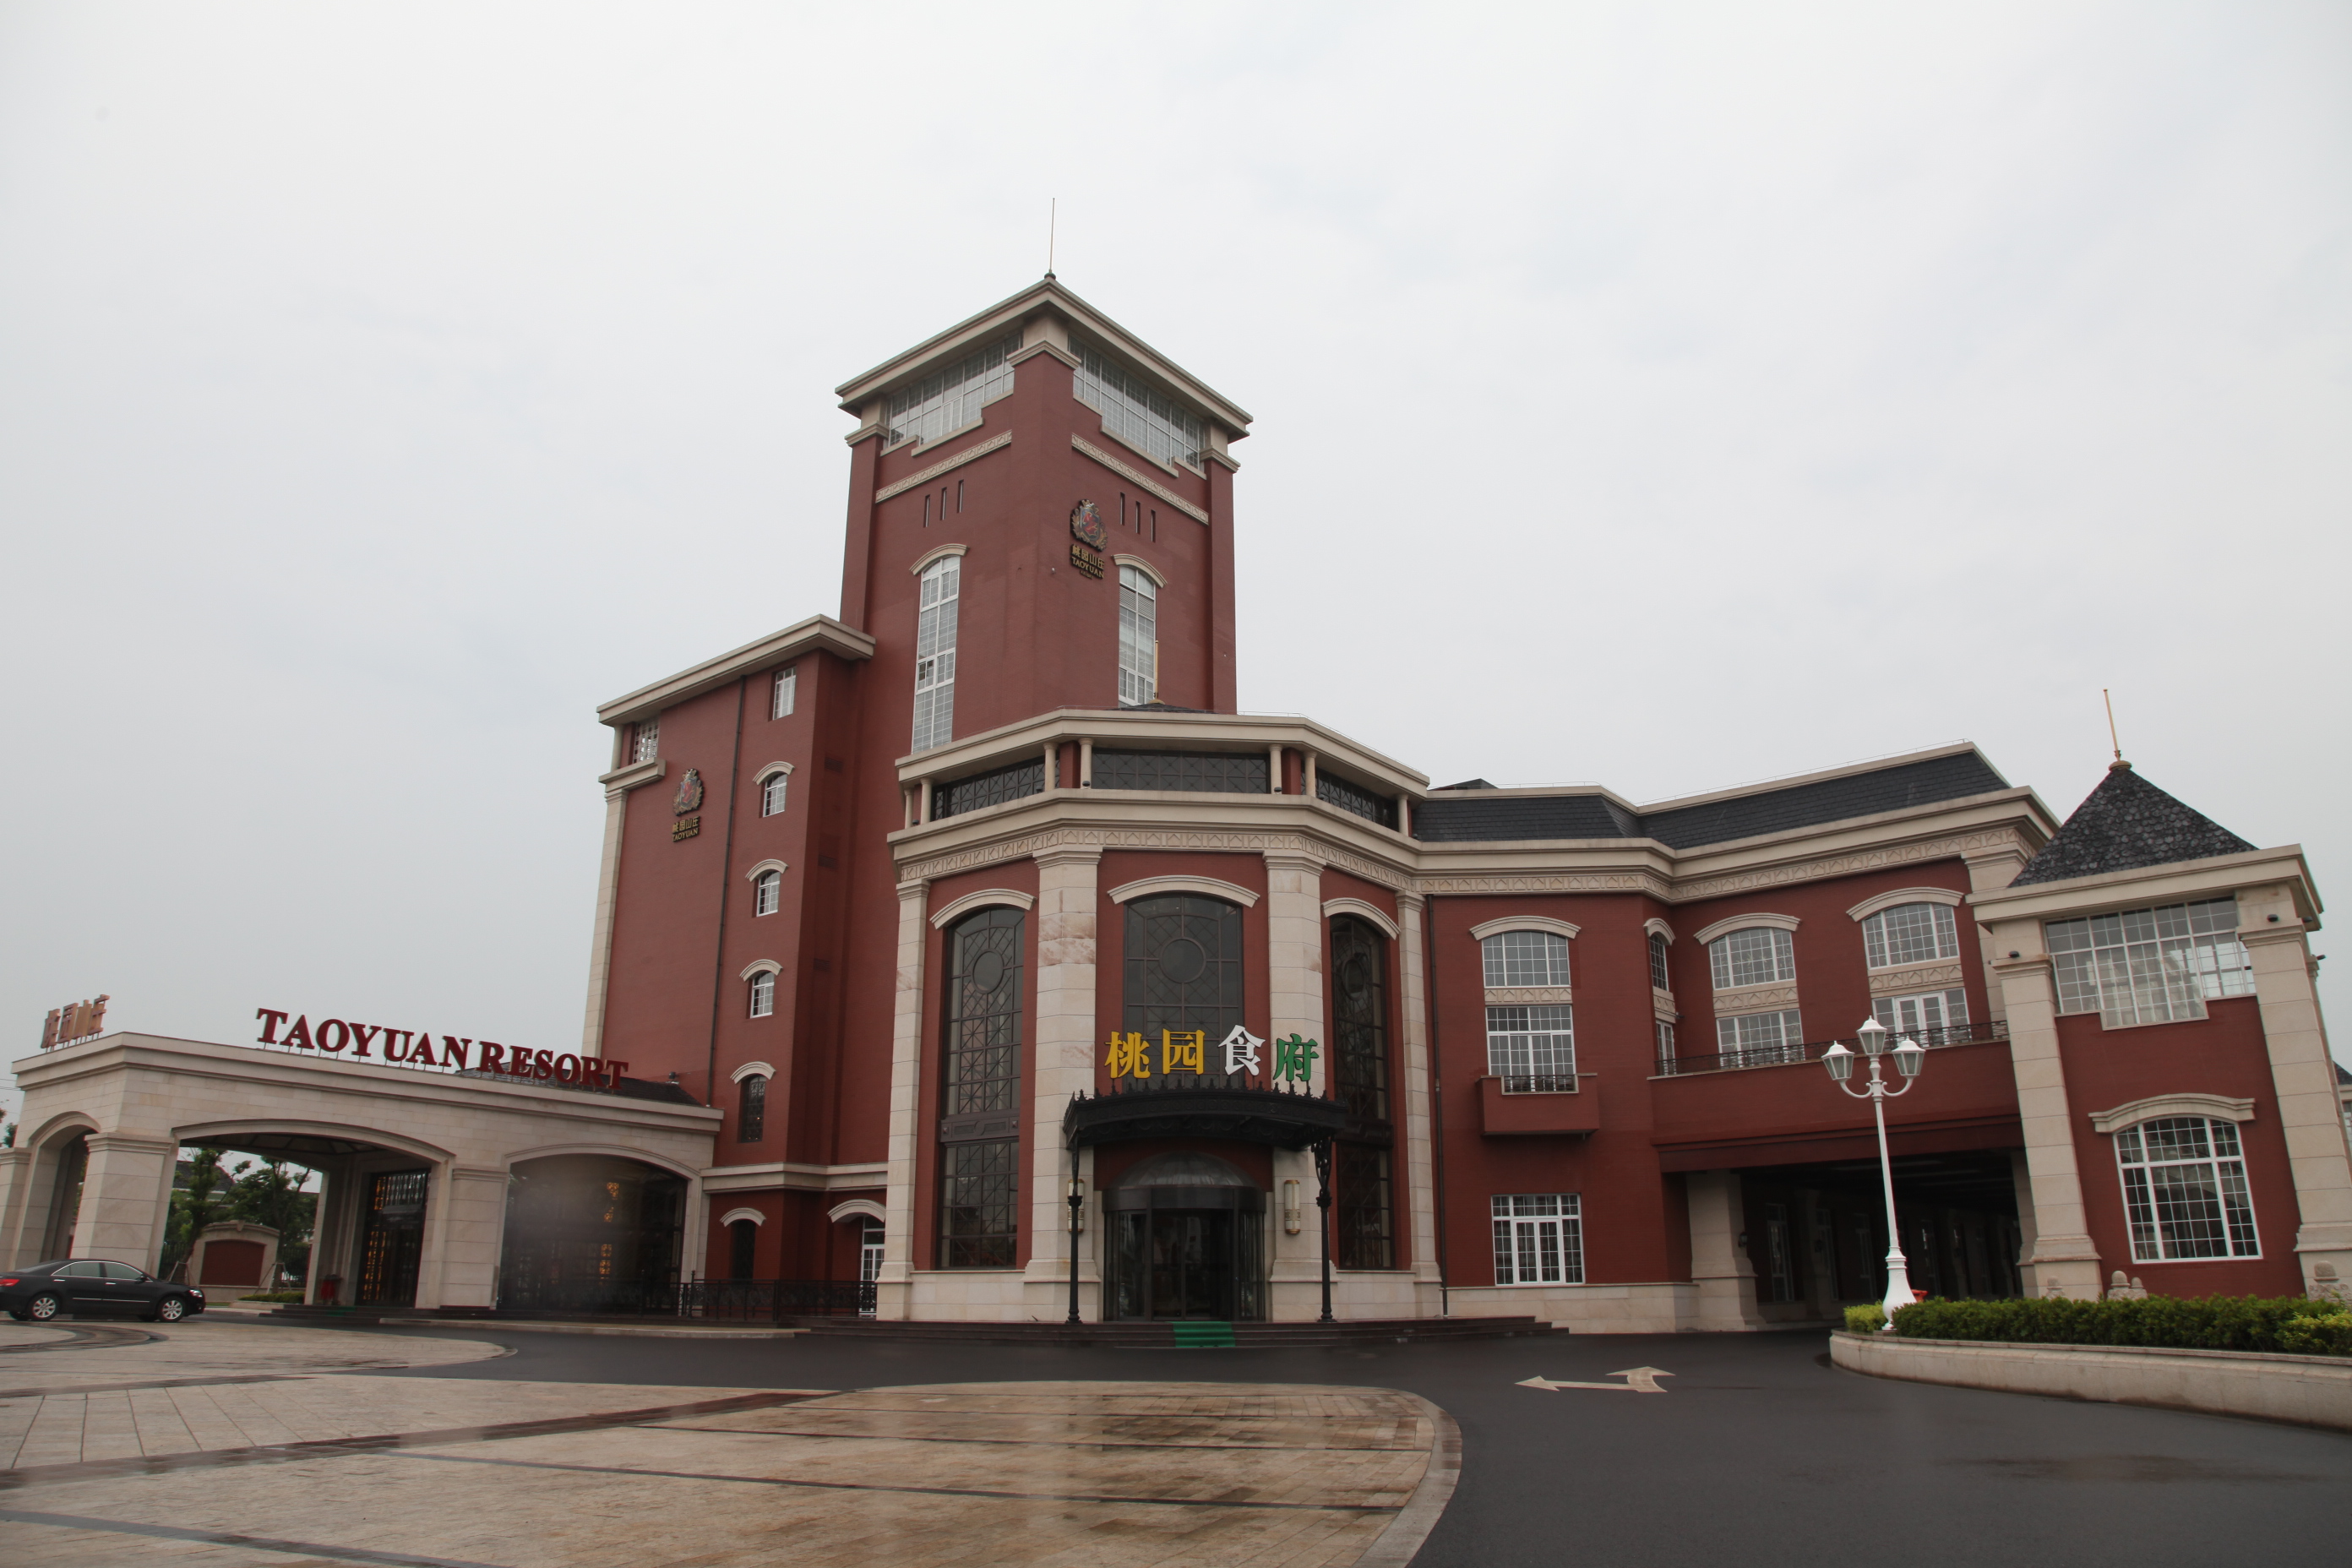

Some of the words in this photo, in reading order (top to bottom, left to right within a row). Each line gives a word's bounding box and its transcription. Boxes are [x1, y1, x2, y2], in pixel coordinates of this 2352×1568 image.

[1072, 556, 1104, 579] TAOYUAN
[672, 827, 699, 842] TAOYUAN
[256, 1008, 472, 1070] TAOYUAN
[478, 1041, 629, 1090] RESORT
[1104, 1024, 1320, 1082] 桃园食府
